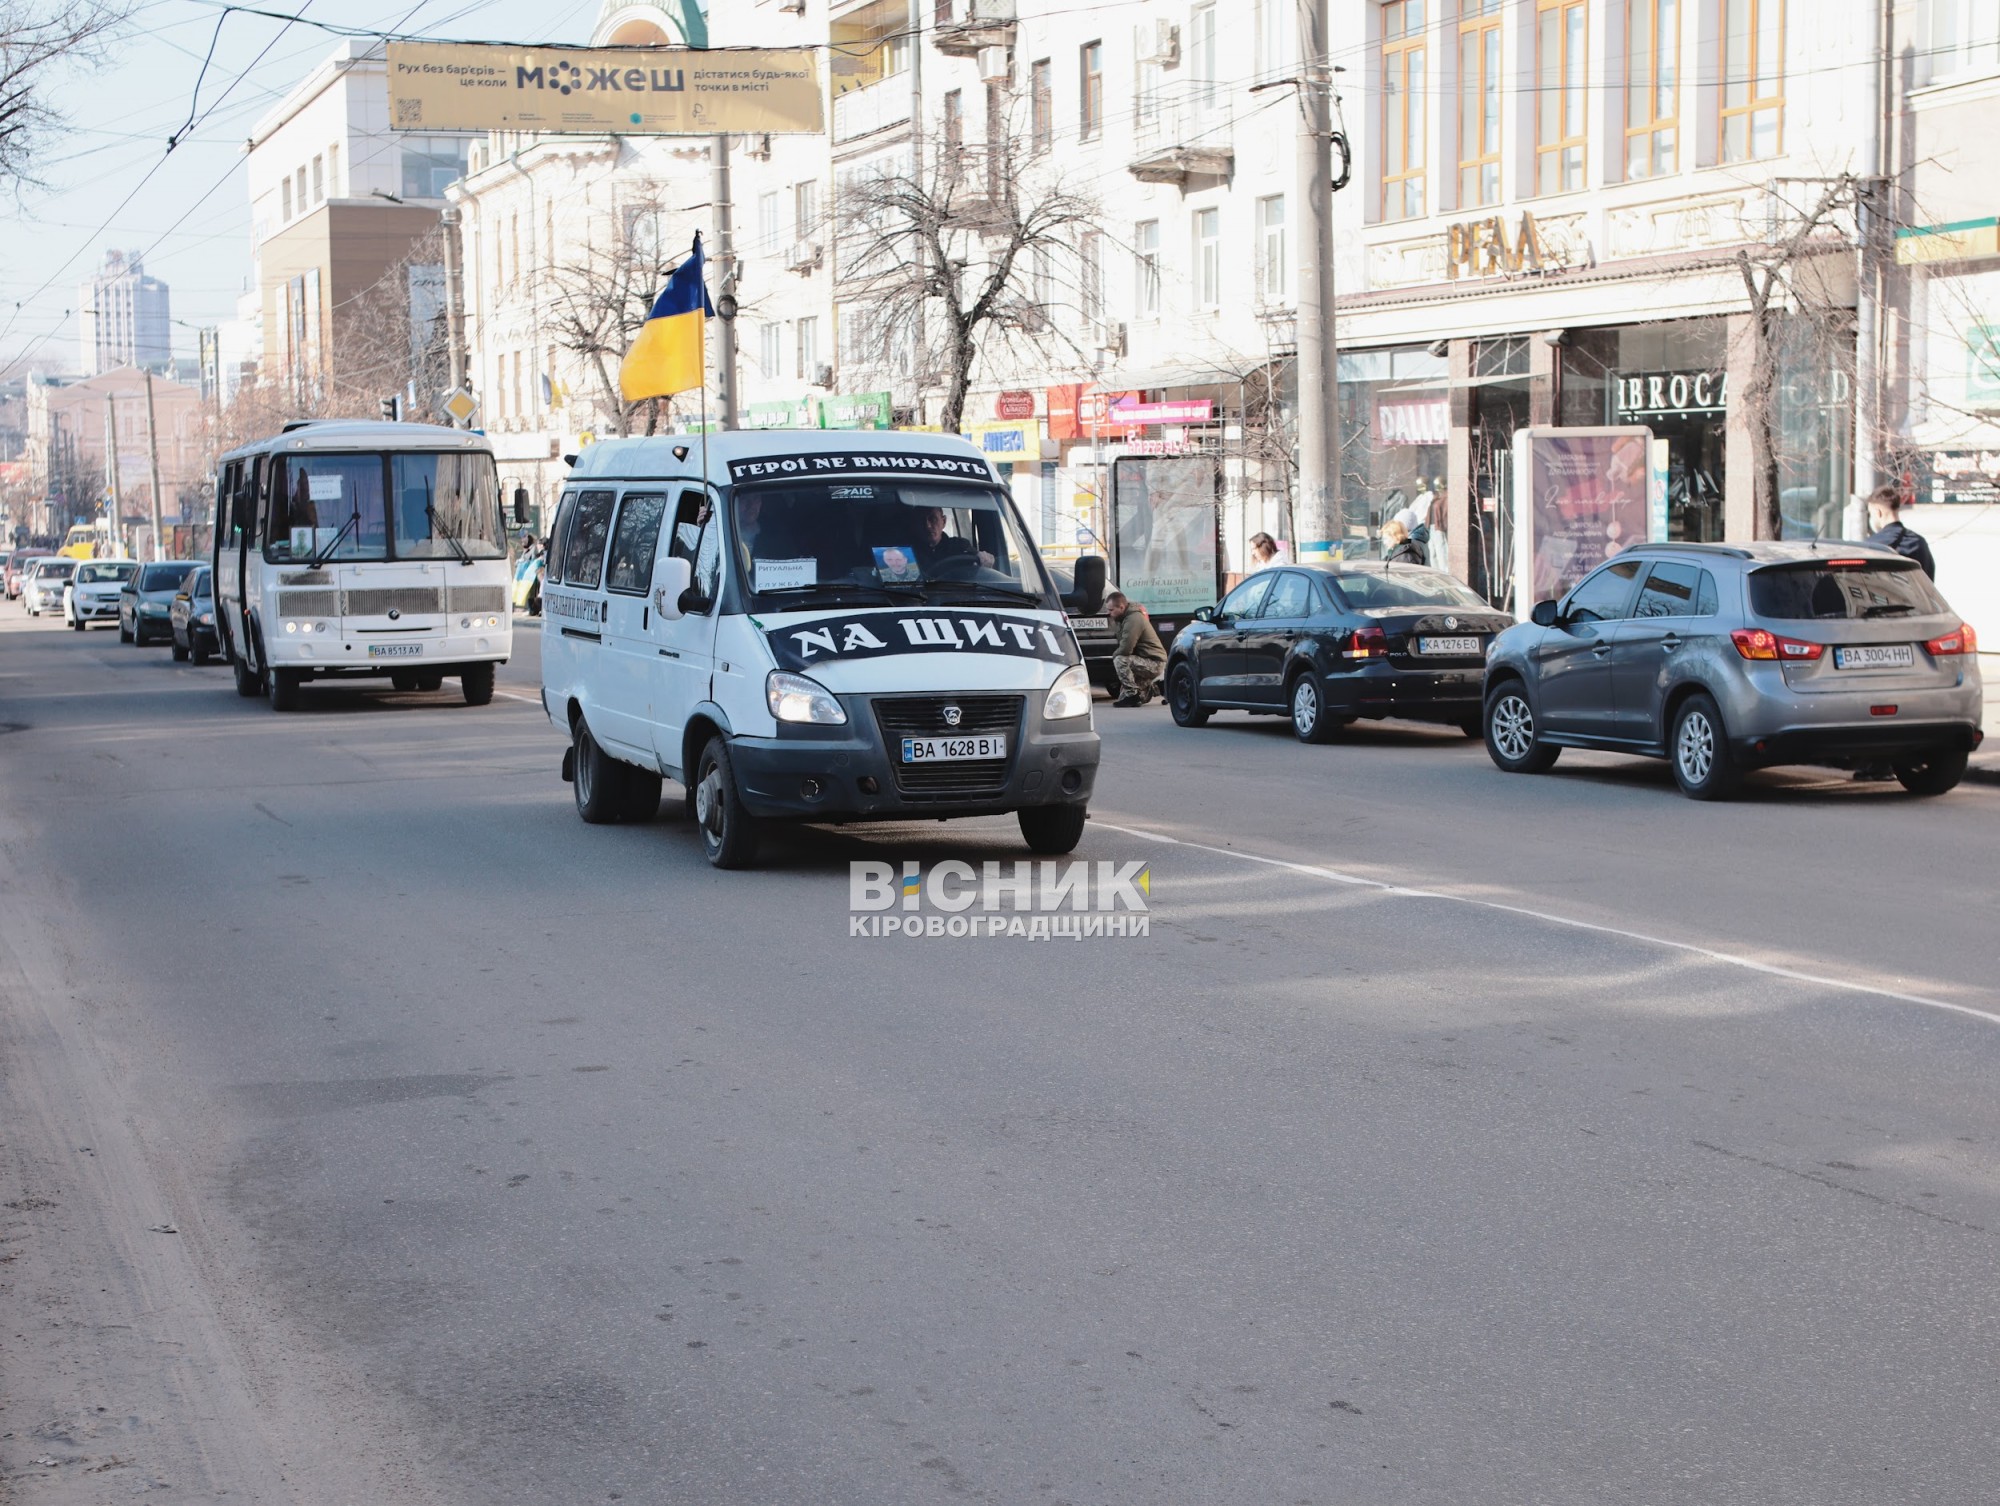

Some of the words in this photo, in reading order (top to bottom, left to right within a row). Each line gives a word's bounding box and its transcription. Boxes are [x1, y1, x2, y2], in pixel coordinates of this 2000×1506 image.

[398, 63, 420, 74] Рух
[423, 64, 444, 74] без
[694, 69, 750, 80] дістатися
[752, 69, 810, 81] будь-якої
[460, 78, 476, 87] це
[478, 78, 507, 87] коли
[695, 83, 730, 92] точки
[733, 84, 739, 92] в
[741, 82, 769, 92] місті
[851, 456, 988, 476] ВМИРАЮТЬ
[897, 617, 1066, 657] ЩИТІ
[1425, 639, 1440, 650] KA
[1440, 639, 1462, 650] 1276
[1463, 639, 1477, 649] EO
[388, 646, 407, 656] 8513
[1844, 650, 1862, 663] BA
[1864, 649, 1892, 662] 3004
[1892, 648, 1910, 661] HH
[913, 742, 936, 759] BA
[941, 740, 975, 757] 1628
[979, 739, 997, 755] BI
